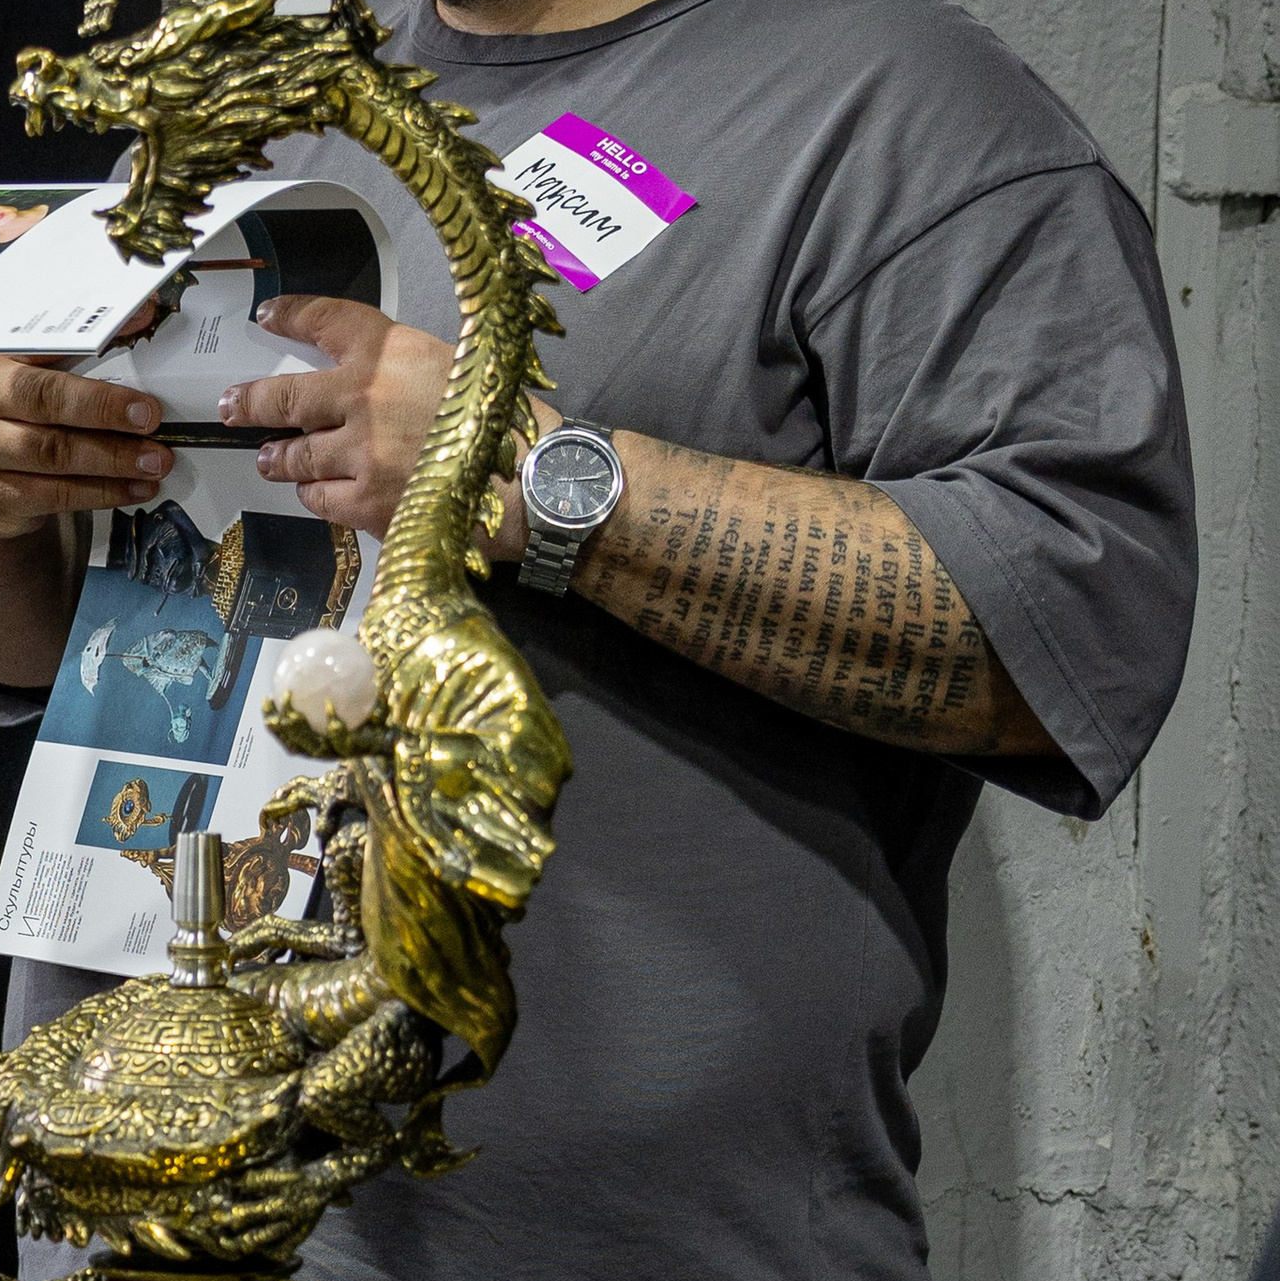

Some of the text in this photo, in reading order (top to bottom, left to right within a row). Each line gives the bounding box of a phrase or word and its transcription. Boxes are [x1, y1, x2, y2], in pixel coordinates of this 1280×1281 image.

[589, 149, 630, 180] my name is
[596, 137, 647, 174] HELLO
